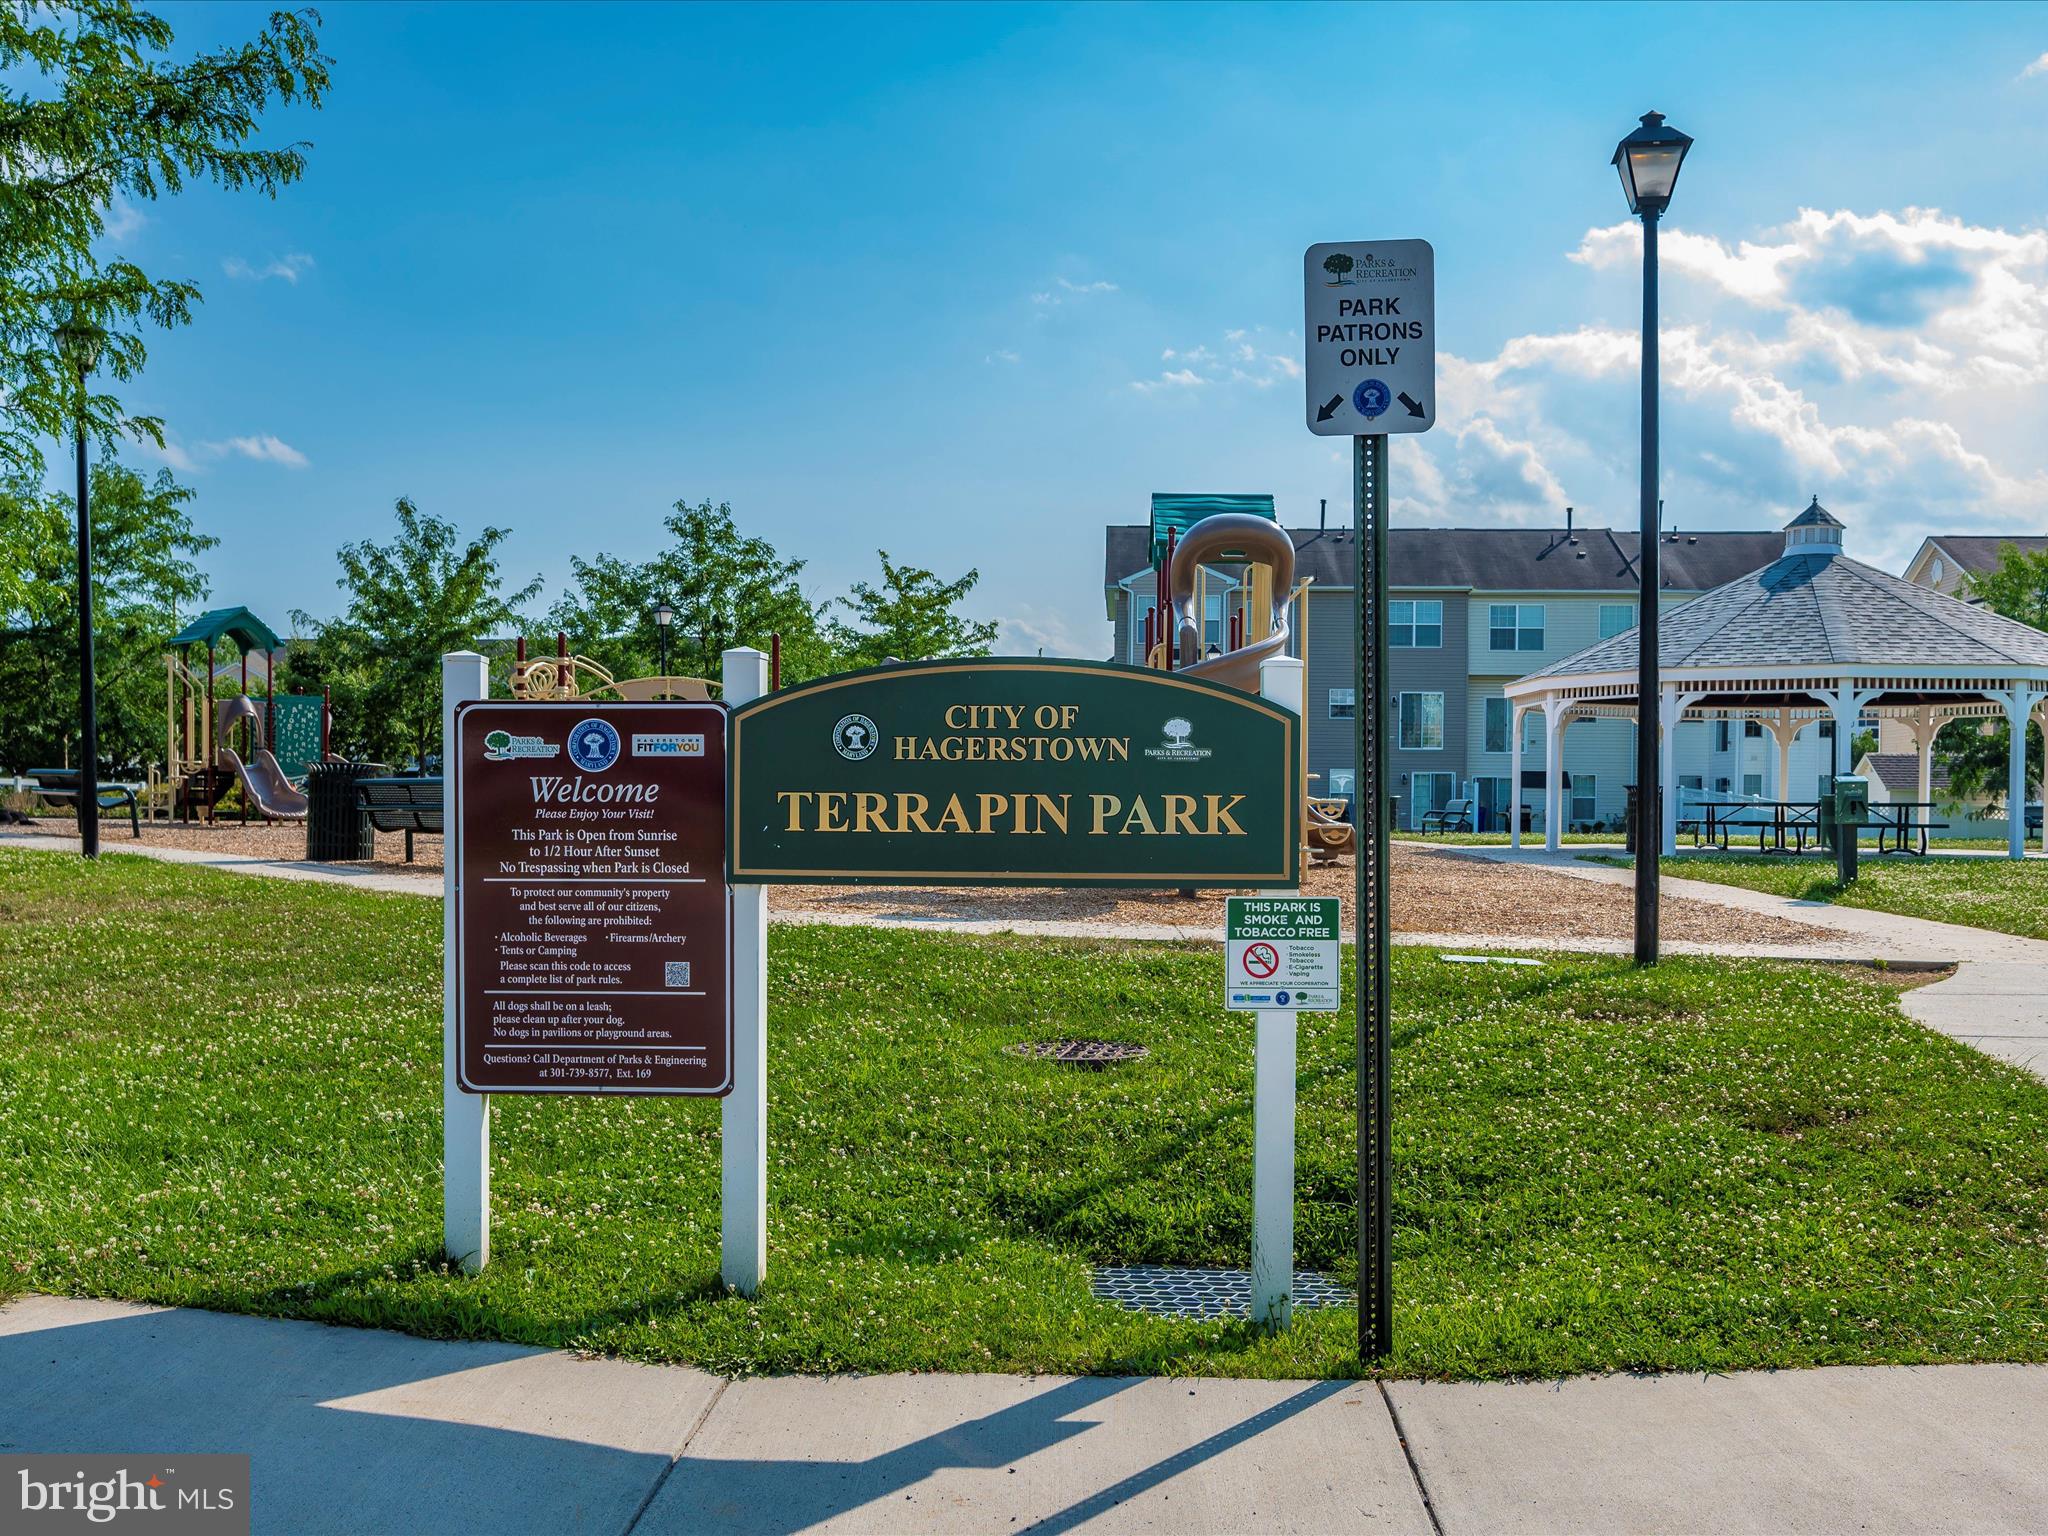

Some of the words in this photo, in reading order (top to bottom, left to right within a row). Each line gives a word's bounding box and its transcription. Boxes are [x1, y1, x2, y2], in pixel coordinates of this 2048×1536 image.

[1356, 259, 1386, 268] PARKS
[1388, 259, 1395, 268] &
[1356, 268, 1416, 278] RECREATION
[1339, 298, 1400, 317] PARK
[1317, 321, 1423, 343] PATRONS
[1340, 347, 1400, 367] ONLY
[945, 704, 1021, 730] CITY
[1034, 705, 1079, 730] OF
[894, 736, 1129, 761] HAGERSTOWN
[530, 776, 658, 802] Welcome
[536, 809, 566, 818] Please
[570, 809, 598, 821] Enjoy
[602, 809, 626, 818] Your
[629, 809, 654, 818] Visit!
[777, 791, 1072, 835] TERRAPIN
[1088, 794, 1247, 836] PARK
[512, 829, 535, 840] This
[539, 829, 562, 840] Park
[566, 830, 574, 840] is
[578, 830, 606, 843] Open
[609, 829, 634, 840] from
[638, 830, 677, 840] Sunrise
[530, 847, 540, 856] to
[545, 845, 560, 856] 1/2
[564, 846, 592, 856] Hour
[595, 845, 622, 856] After
[624, 846, 660, 857] Sunset
[500, 862, 516, 872] No
[518, 862, 580, 876] Trespassing
[582, 862, 611, 872] when
[615, 862, 638, 873] Park
[642, 862, 650, 873] is
[653, 862, 689, 873] Closed
[510, 888, 521, 896] To
[524, 889, 554, 898] protect
[575, 888, 630, 899] community's
[632, 890, 670, 900] property
[520, 901, 536, 910] and
[539, 901, 556, 910] best
[584, 902, 594, 910] all
[597, 902, 606, 911] of
[626, 902, 660, 912] citizens,
[1244, 902, 1270, 912] THIS
[1274, 902, 1307, 912] PARK
[1310, 902, 1320, 912] IS
[529, 915, 542, 924] the
[545, 915, 586, 927] following
[604, 916, 651, 927] prohibited:
[1244, 915, 1288, 924] SMOKE
[1296, 915, 1322, 924] AND
[501, 932, 542, 941] Alcoholic
[545, 933, 587, 944] Beverages
[1235, 928, 1296, 937] TOBACCO
[1299, 928, 1330, 937] FREE
[610, 933, 686, 945] Firearms/Archery
[500, 946, 524, 954] Tents
[538, 946, 577, 957] Camping
[501, 961, 527, 970] Please
[552, 961, 567, 970] this
[570, 962, 590, 970] code
[508, 974, 547, 986] complete
[550, 974, 562, 983] list
[565, 974, 574, 983] of
[577, 975, 596, 986] park
[599, 975, 622, 984] rules.
[493, 1001, 505, 1010] All
[508, 1001, 528, 1012] dogs
[531, 1001, 550, 1010] shall
[553, 1002, 563, 1010] be
[587, 1002, 611, 1012] leash;
[494, 1014, 520, 1025] please
[523, 1014, 545, 1023] clean
[548, 1017, 559, 1026] up
[562, 1014, 581, 1023] after
[584, 1017, 604, 1026] your
[606, 1015, 624, 1026] dog.
[494, 1028, 506, 1036] No
[509, 1028, 529, 1039] dogs
[532, 1028, 540, 1036] in
[543, 1028, 581, 1039] pavilions
[596, 1028, 644, 1039] playground
[484, 1054, 530, 1064] Questions?
[534, 1054, 550, 1063] Call
[553, 1054, 604, 1066] Department
[608, 1054, 616, 1063] of
[619, 1055, 642, 1064] Parks
[645, 1055, 652, 1064] &
[655, 1056, 706, 1067] Engineering
[551, 1068, 612, 1078] 301-739-8577,
[617, 1069, 633, 1077] Ext.
[637, 1069, 651, 1078] 169
